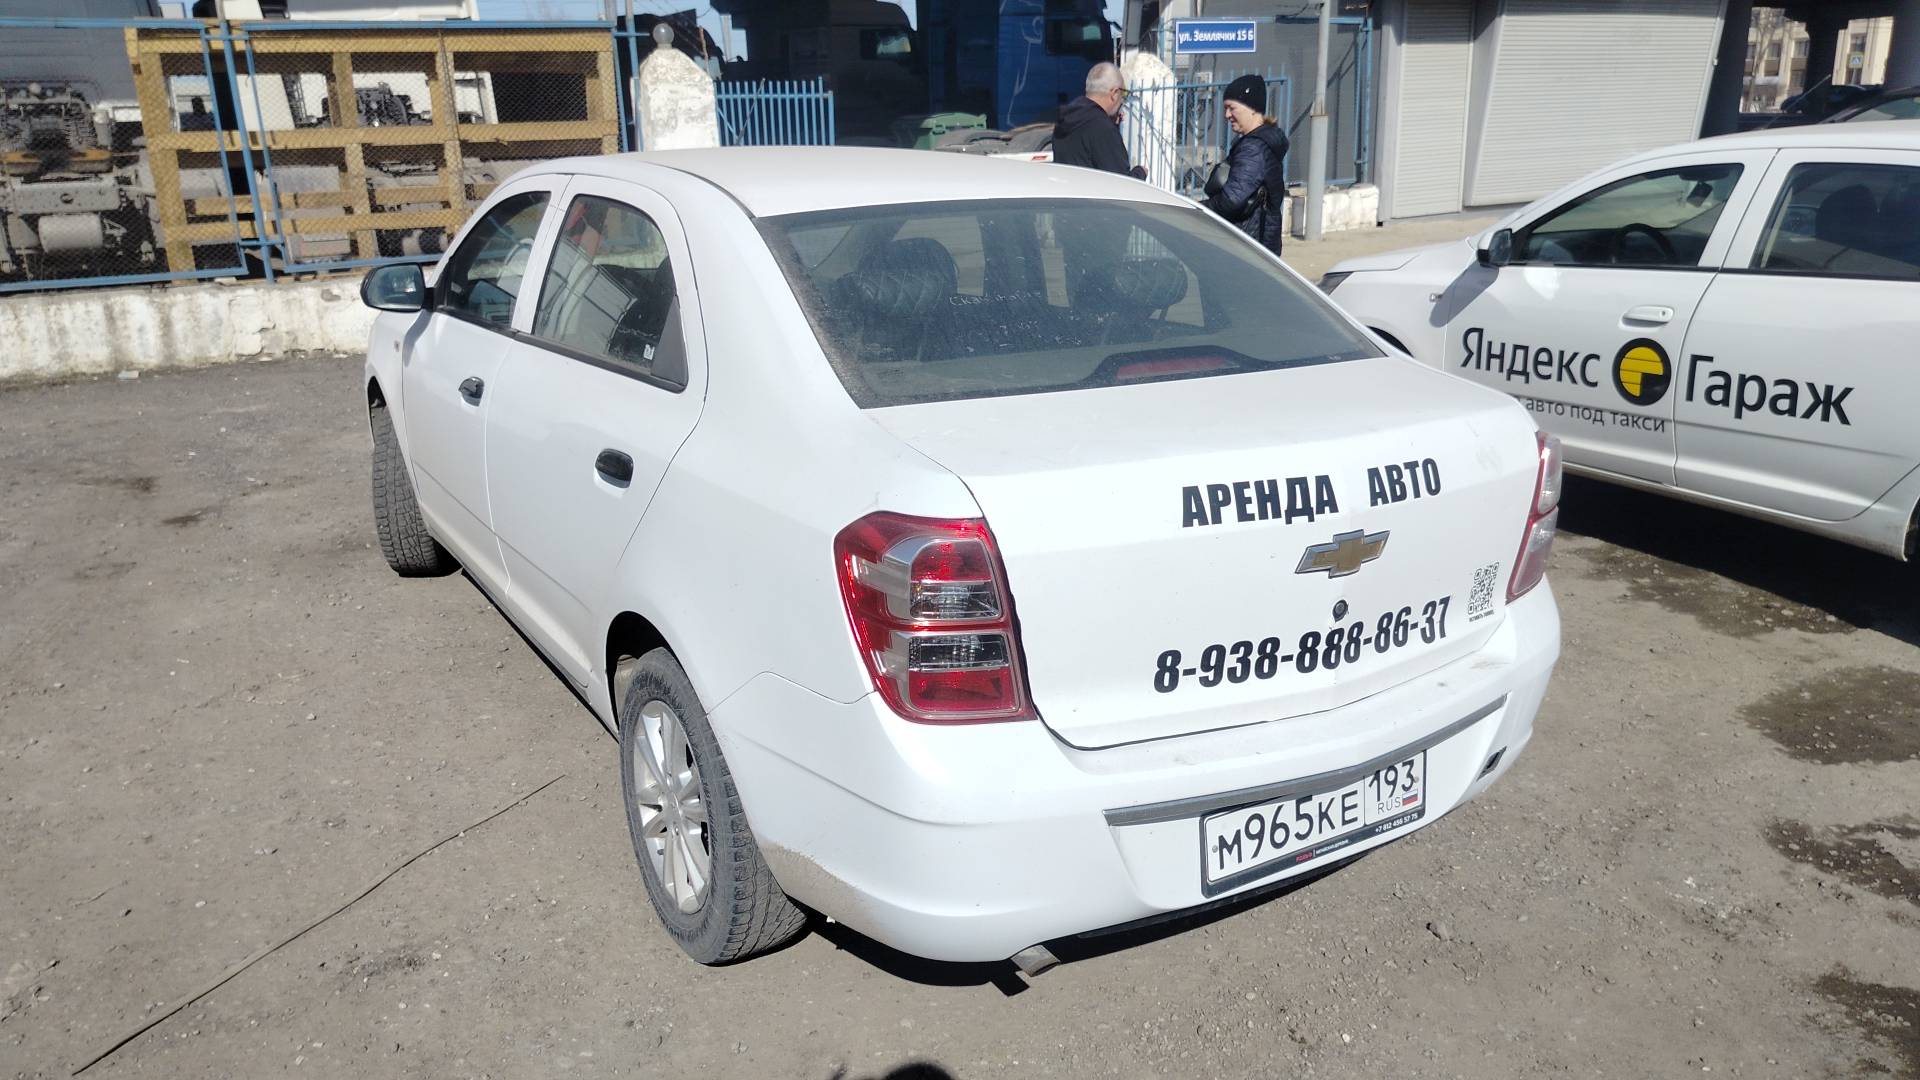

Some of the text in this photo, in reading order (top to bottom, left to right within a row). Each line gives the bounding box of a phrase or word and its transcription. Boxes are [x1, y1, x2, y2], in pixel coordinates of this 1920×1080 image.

[1179, 31, 1192, 44] ул.
[1193, 30, 1235, 42] Землячки
[1237, 30, 1247, 41] 15
[1460, 327, 1855, 426] Яндекс Гараж
[1526, 400, 1665, 432] авто под такси
[1182, 457, 1442, 528] АРЕНДА АВТО
[1153, 595, 1451, 694] 8-938-888-86-37
[1368, 759, 1415, 802] 193
[1377, 797, 1401, 816] RUS
